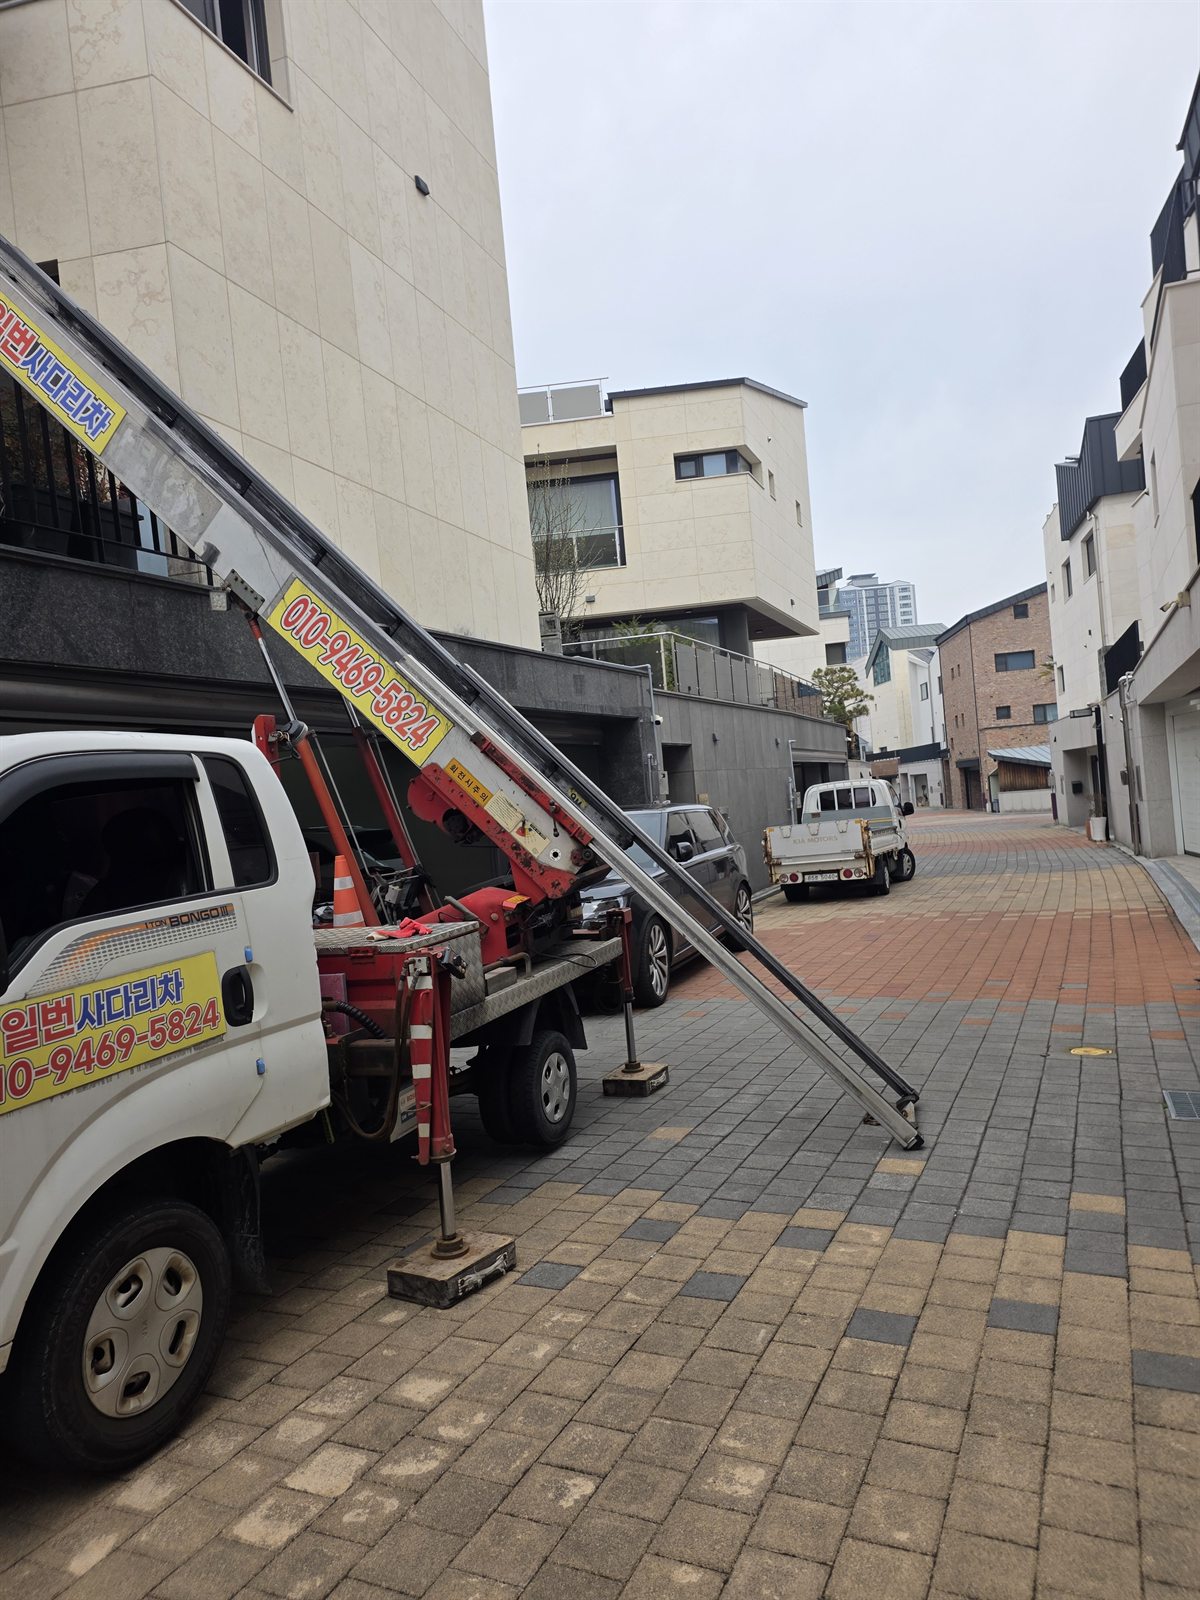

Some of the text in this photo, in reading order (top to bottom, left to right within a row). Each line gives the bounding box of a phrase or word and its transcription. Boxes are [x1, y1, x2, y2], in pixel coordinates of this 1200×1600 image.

[281, 595, 439, 749] 010-9469-5824
[168, 907, 219, 927] BONGO
[2, 969, 183, 1056] 일번사다리차
